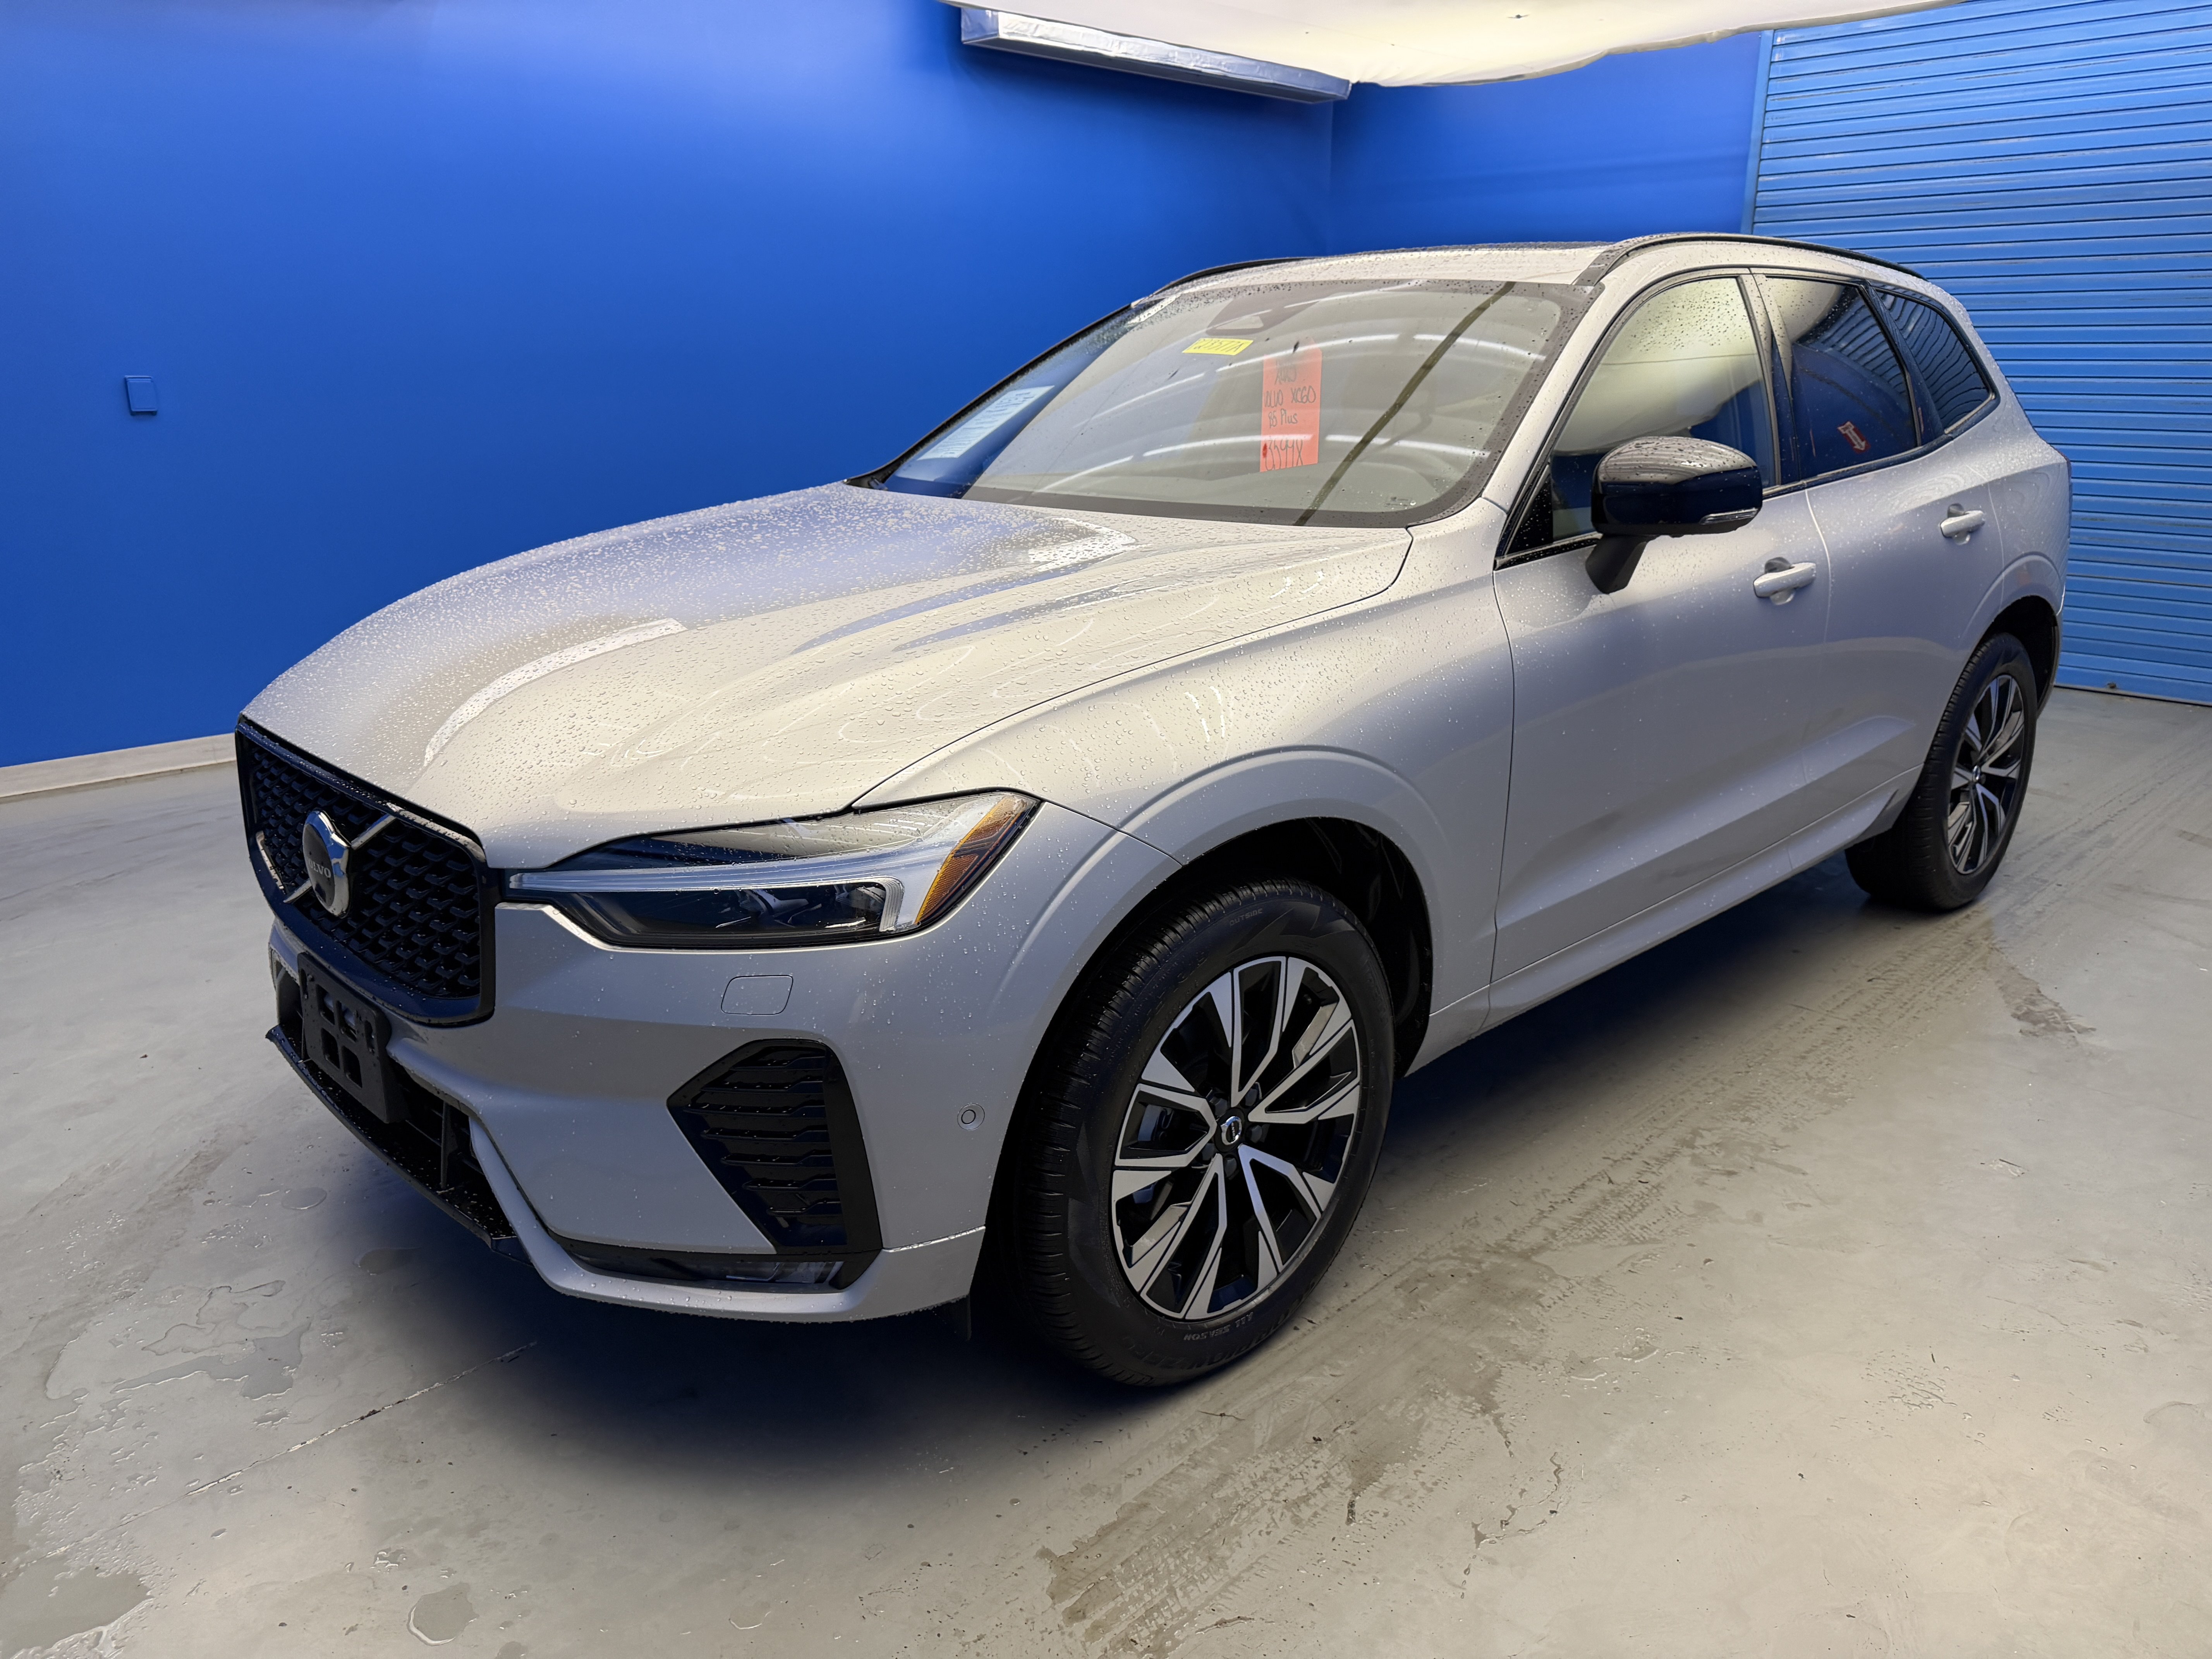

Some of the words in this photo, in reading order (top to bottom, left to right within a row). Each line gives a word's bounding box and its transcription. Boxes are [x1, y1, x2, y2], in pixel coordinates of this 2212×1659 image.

[1290, 385, 1316, 404] XC60
[1280, 408, 1298, 425] Plus
[309, 857, 331, 878] OLVO
[1230, 908, 1262, 926] OUTSIDE
[1235, 1311, 1254, 1328] ALL
[1183, 1324, 1231, 1340] SEASON
